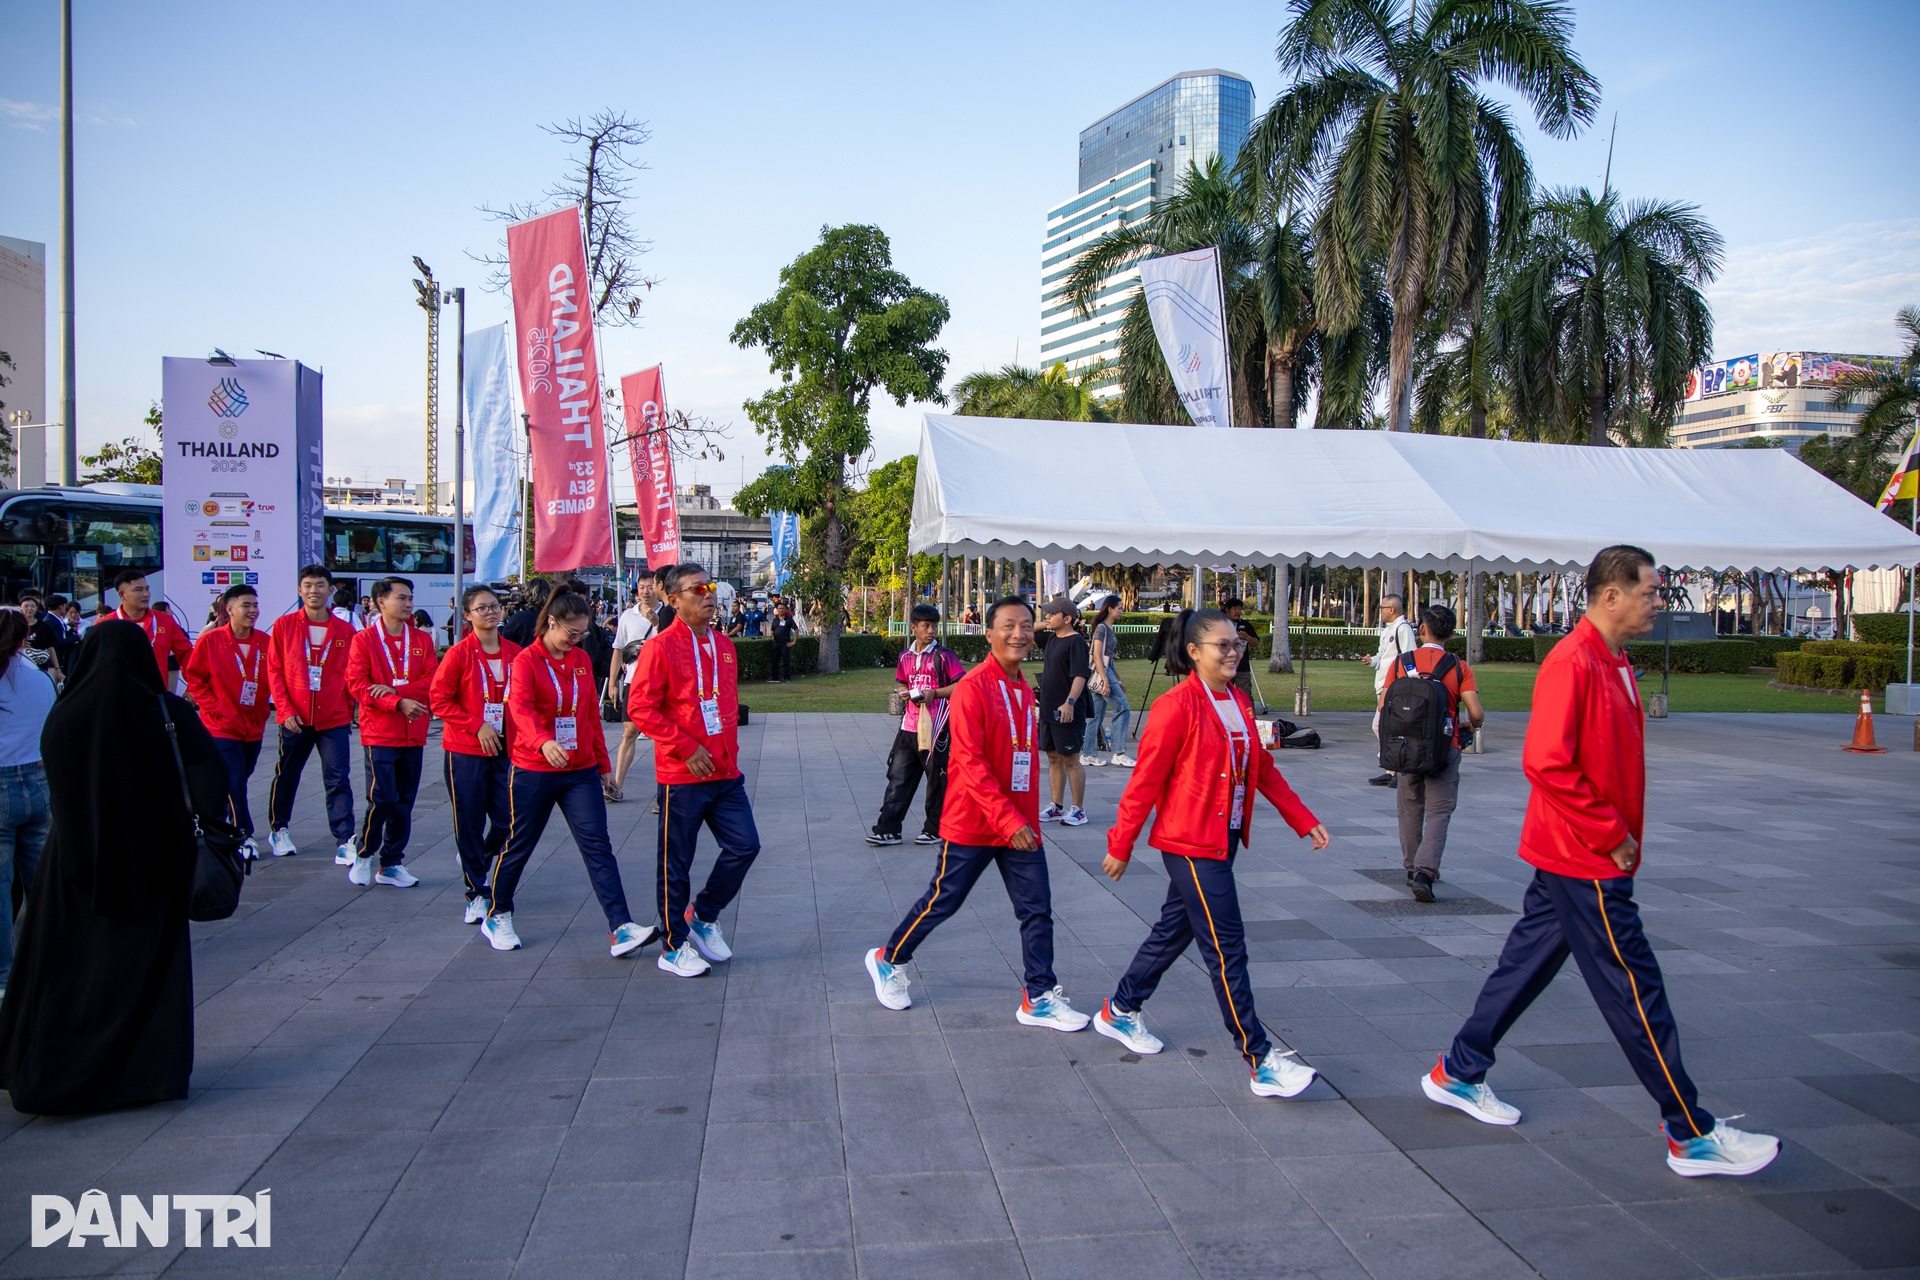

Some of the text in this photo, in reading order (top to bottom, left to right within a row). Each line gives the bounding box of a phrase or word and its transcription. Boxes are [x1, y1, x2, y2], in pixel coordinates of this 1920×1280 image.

[1761, 404, 1788, 414] FBT
[177, 441, 280, 458] THAILAND
[211, 460, 248, 472] 2025
[204, 505, 218, 513] CP
